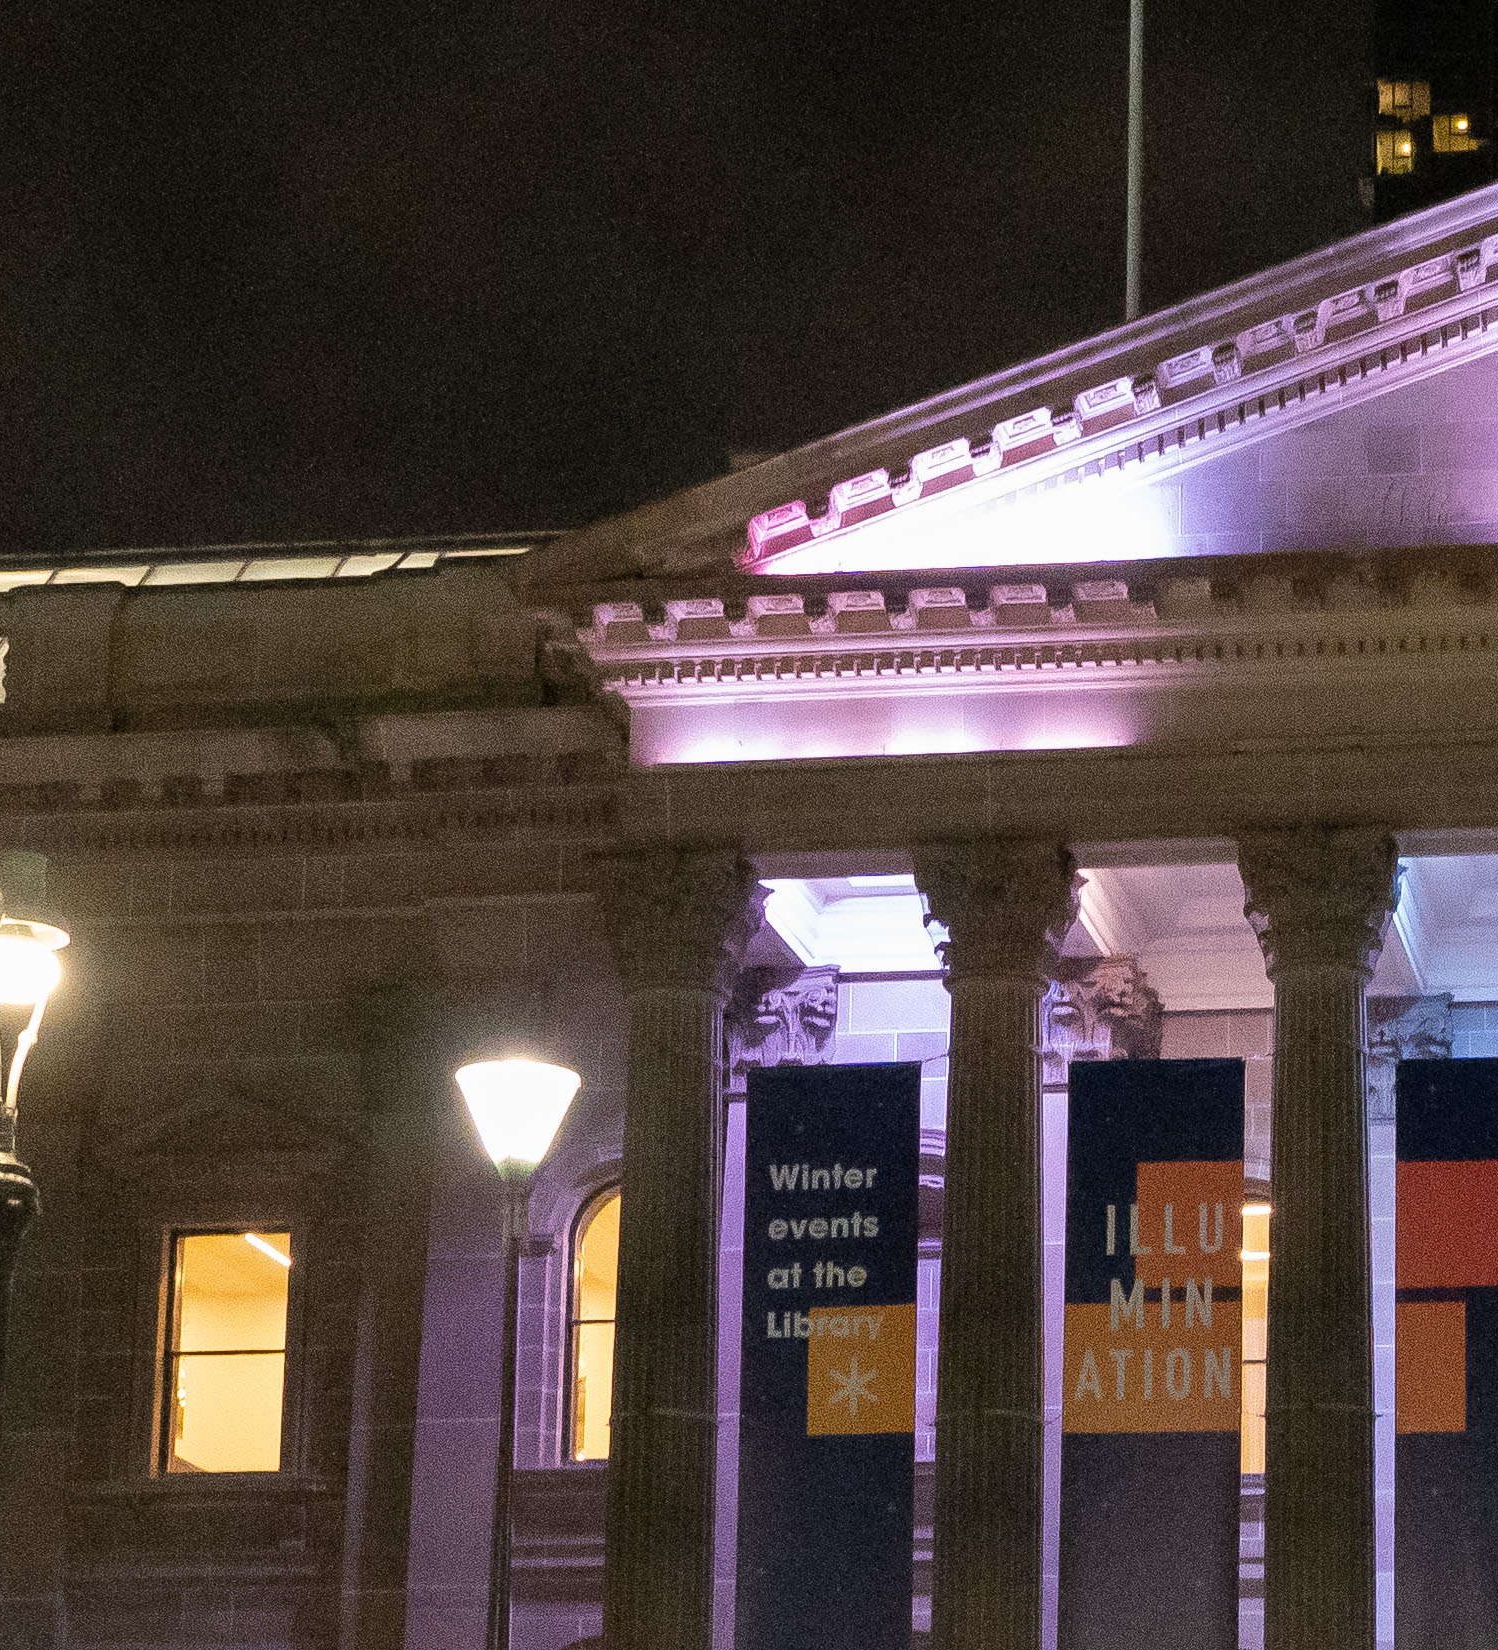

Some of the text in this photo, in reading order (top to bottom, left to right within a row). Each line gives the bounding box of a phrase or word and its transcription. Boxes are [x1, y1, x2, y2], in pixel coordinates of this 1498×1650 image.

[769, 1163, 877, 1191] Winter
[767, 1211, 880, 1240] events
[1105, 1202, 1225, 1256] ILLU
[767, 1260, 867, 1290] at the
[1110, 1277, 1214, 1330] MIN
[766, 1311, 883, 1341] Library
[1074, 1347, 1234, 1402] ATION
